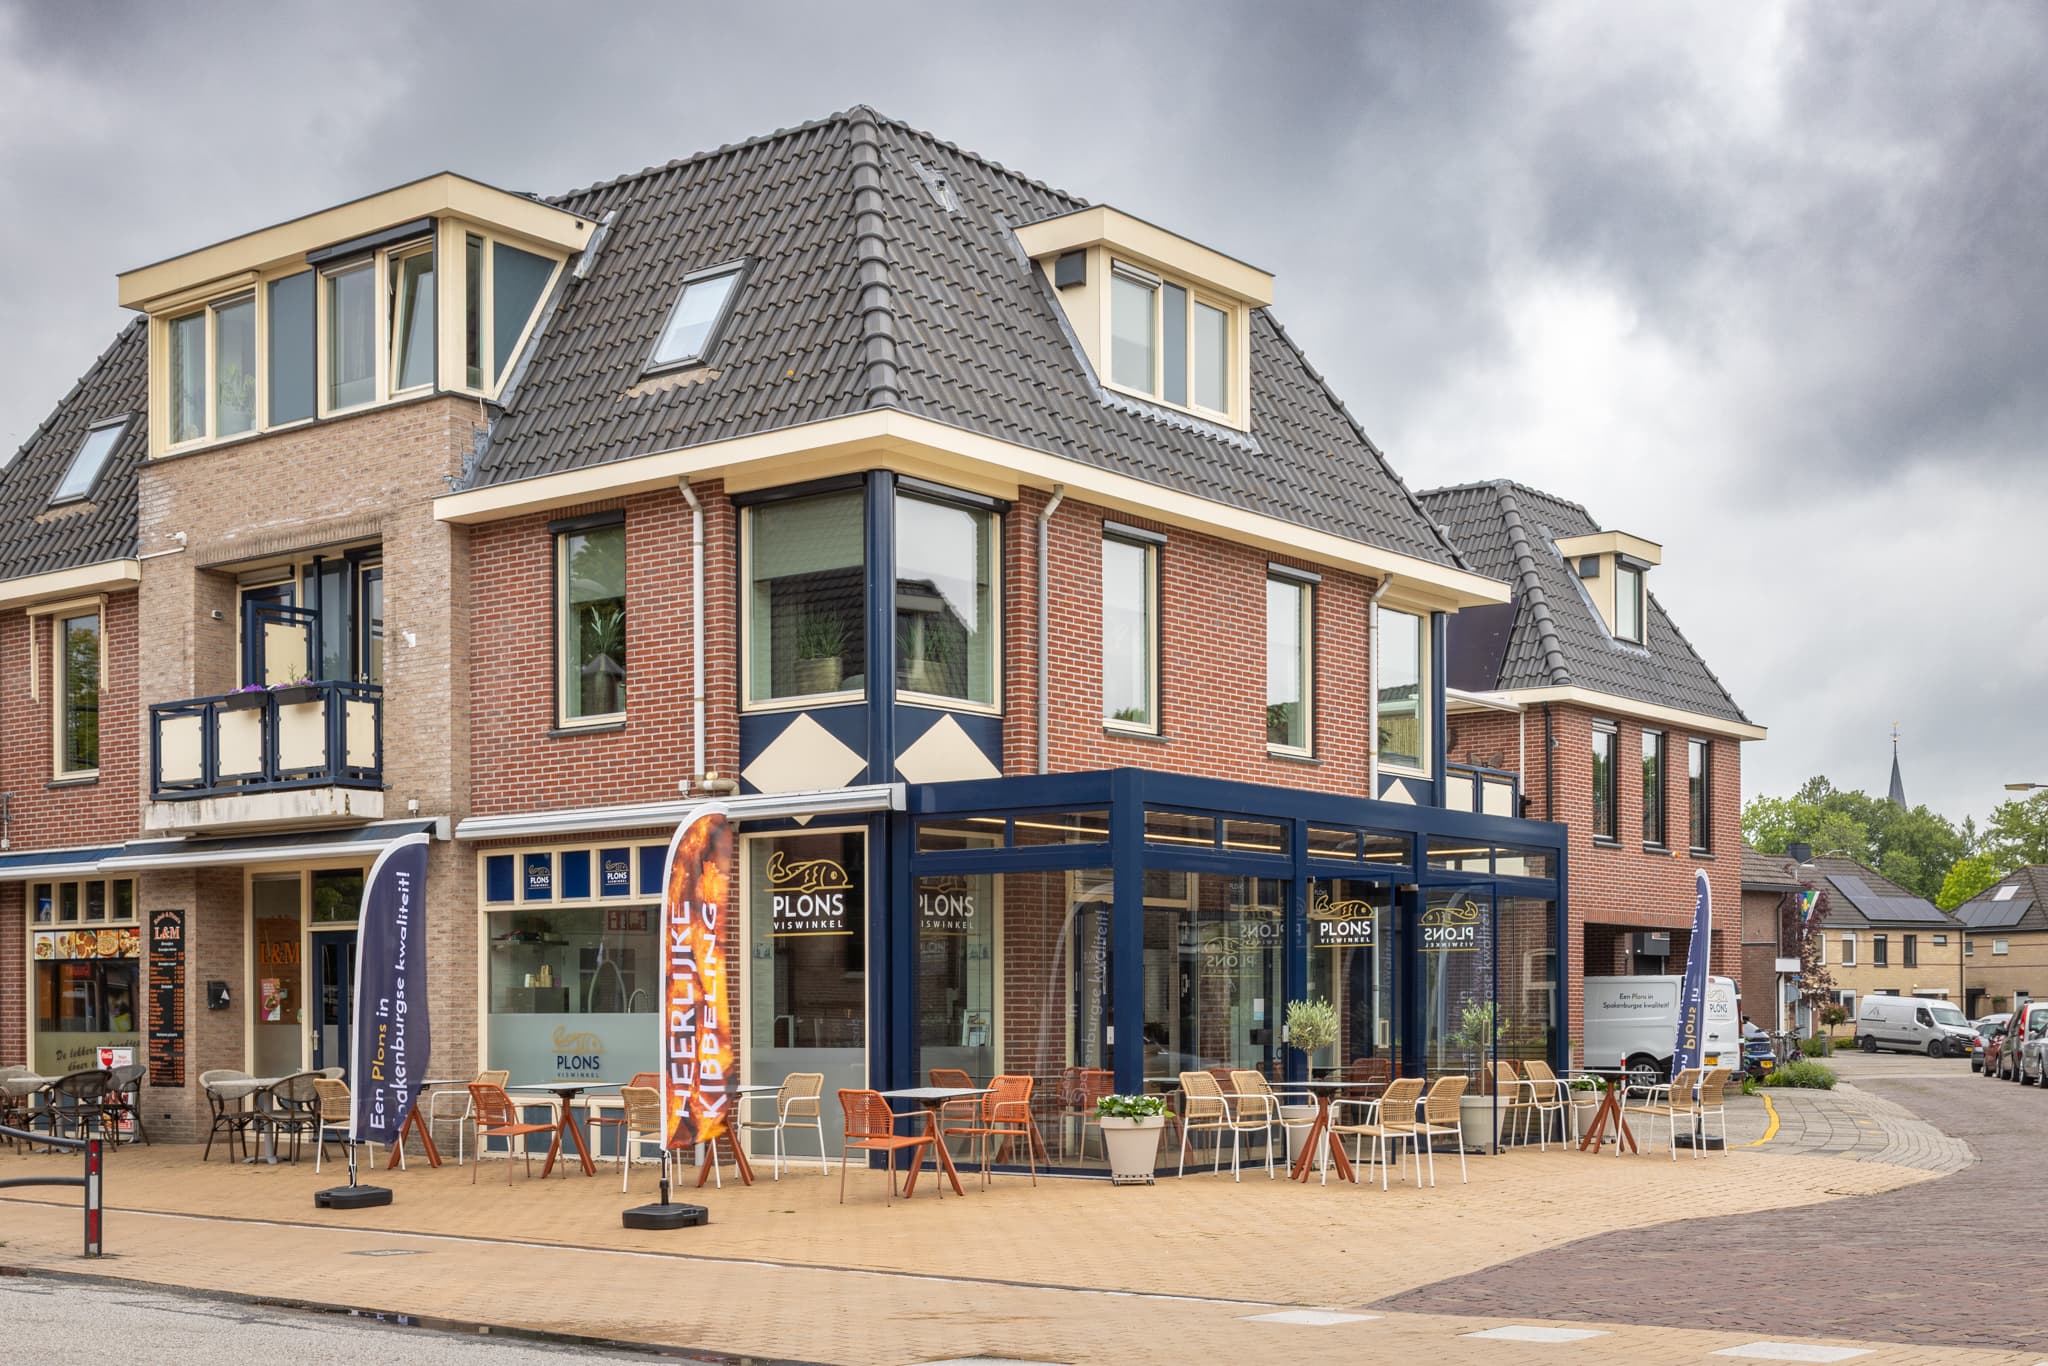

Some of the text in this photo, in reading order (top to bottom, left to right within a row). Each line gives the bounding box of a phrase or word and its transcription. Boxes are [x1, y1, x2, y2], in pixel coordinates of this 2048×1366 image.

[530, 876, 549, 884] PLONS
[607, 872, 627, 880] PLONS
[773, 894, 844, 918] PLONS
[773, 919, 844, 930] VISWINKEL
[920, 920, 974, 929] ISWINKEL
[1320, 921, 1371, 936] PLONS
[154, 926, 180, 940] L&M
[389, 871, 410, 1131] akenburgse kwaliteit!
[1603, 1002, 1642, 1010] Spakenburgse
[670, 901, 697, 1118] HEERLIJKE
[698, 902, 728, 1118] KIBBELING
[1709, 1004, 1728, 1013] PLONS
[370, 997, 389, 1129] Een Plons in
[557, 1055, 600, 1070] PLONS
